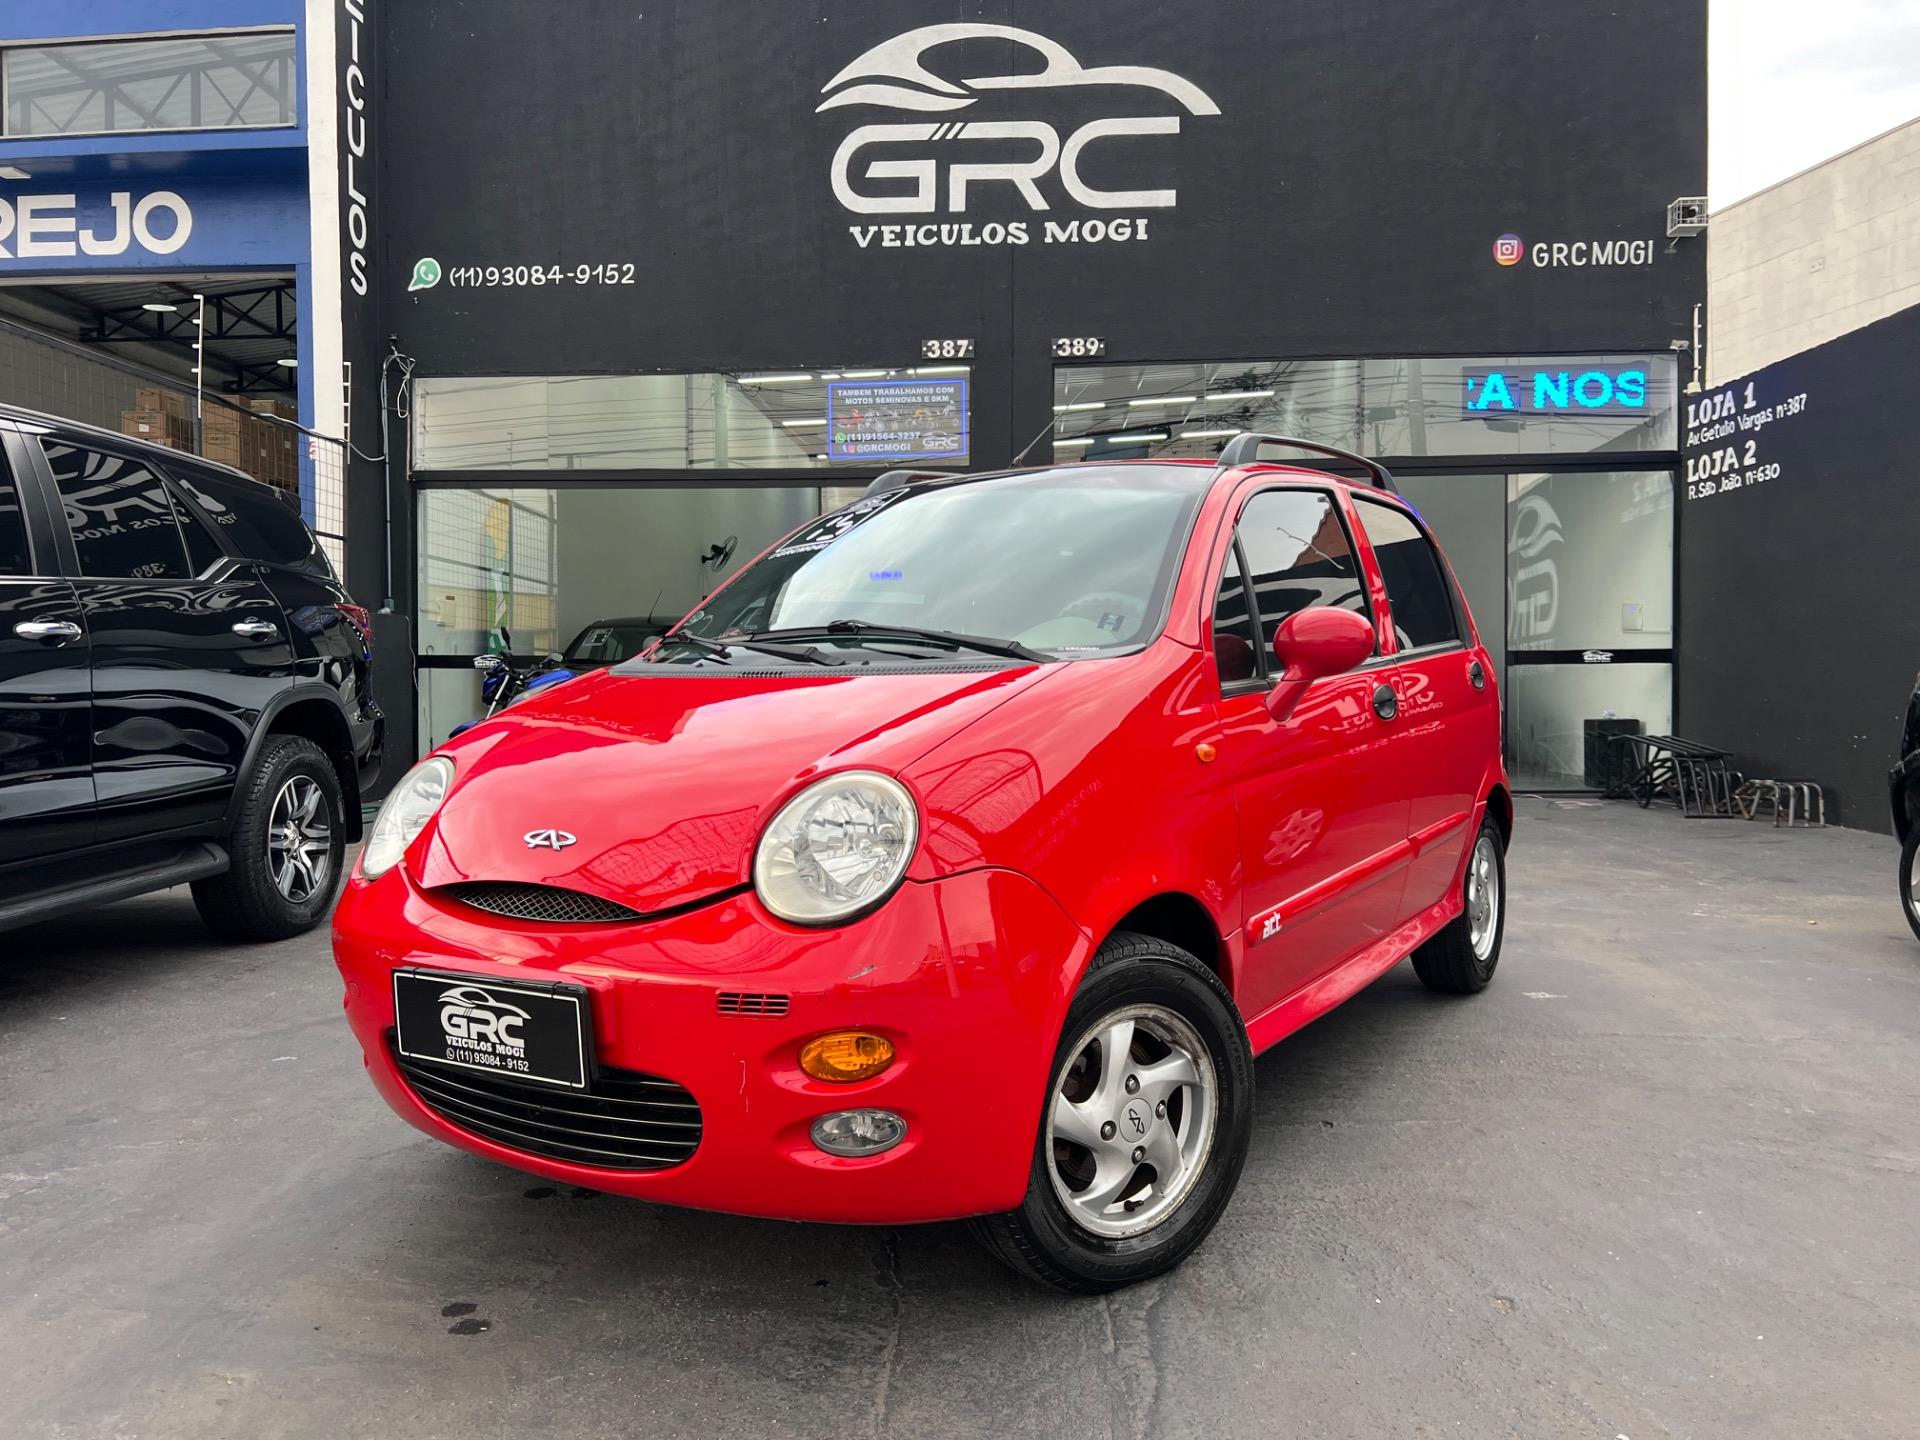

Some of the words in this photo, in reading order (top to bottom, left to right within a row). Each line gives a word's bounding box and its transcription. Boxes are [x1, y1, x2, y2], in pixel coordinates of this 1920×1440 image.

[831, 116, 1180, 213] GRC
[0, 191, 192, 258] EJO
[850, 222, 1029, 248] VEICULOS
[1044, 218, 1149, 243] MOGI
[1532, 240, 1654, 267] GRCMOGI
[927, 340, 969, 358] 387
[1056, 338, 1099, 356] 389
[838, 388, 872, 397] TAMBEM
[873, 387, 934, 396] TRABALHAMOS
[935, 386, 955, 395] COM
[875, 397, 922, 405] SEMINOVAS
[1533, 370, 1646, 409] NOS
[1687, 390, 1736, 429] LOJA
[1743, 381, 1757, 410] 1
[922, 436, 959, 448] GRC
[1687, 446, 1739, 482] LOJA
[1743, 439, 1757, 466] 2
[440, 1005, 525, 1048] GRC
[445, 1034, 493, 1053] VEICULOS
[495, 1043, 525, 1058] MOGI
